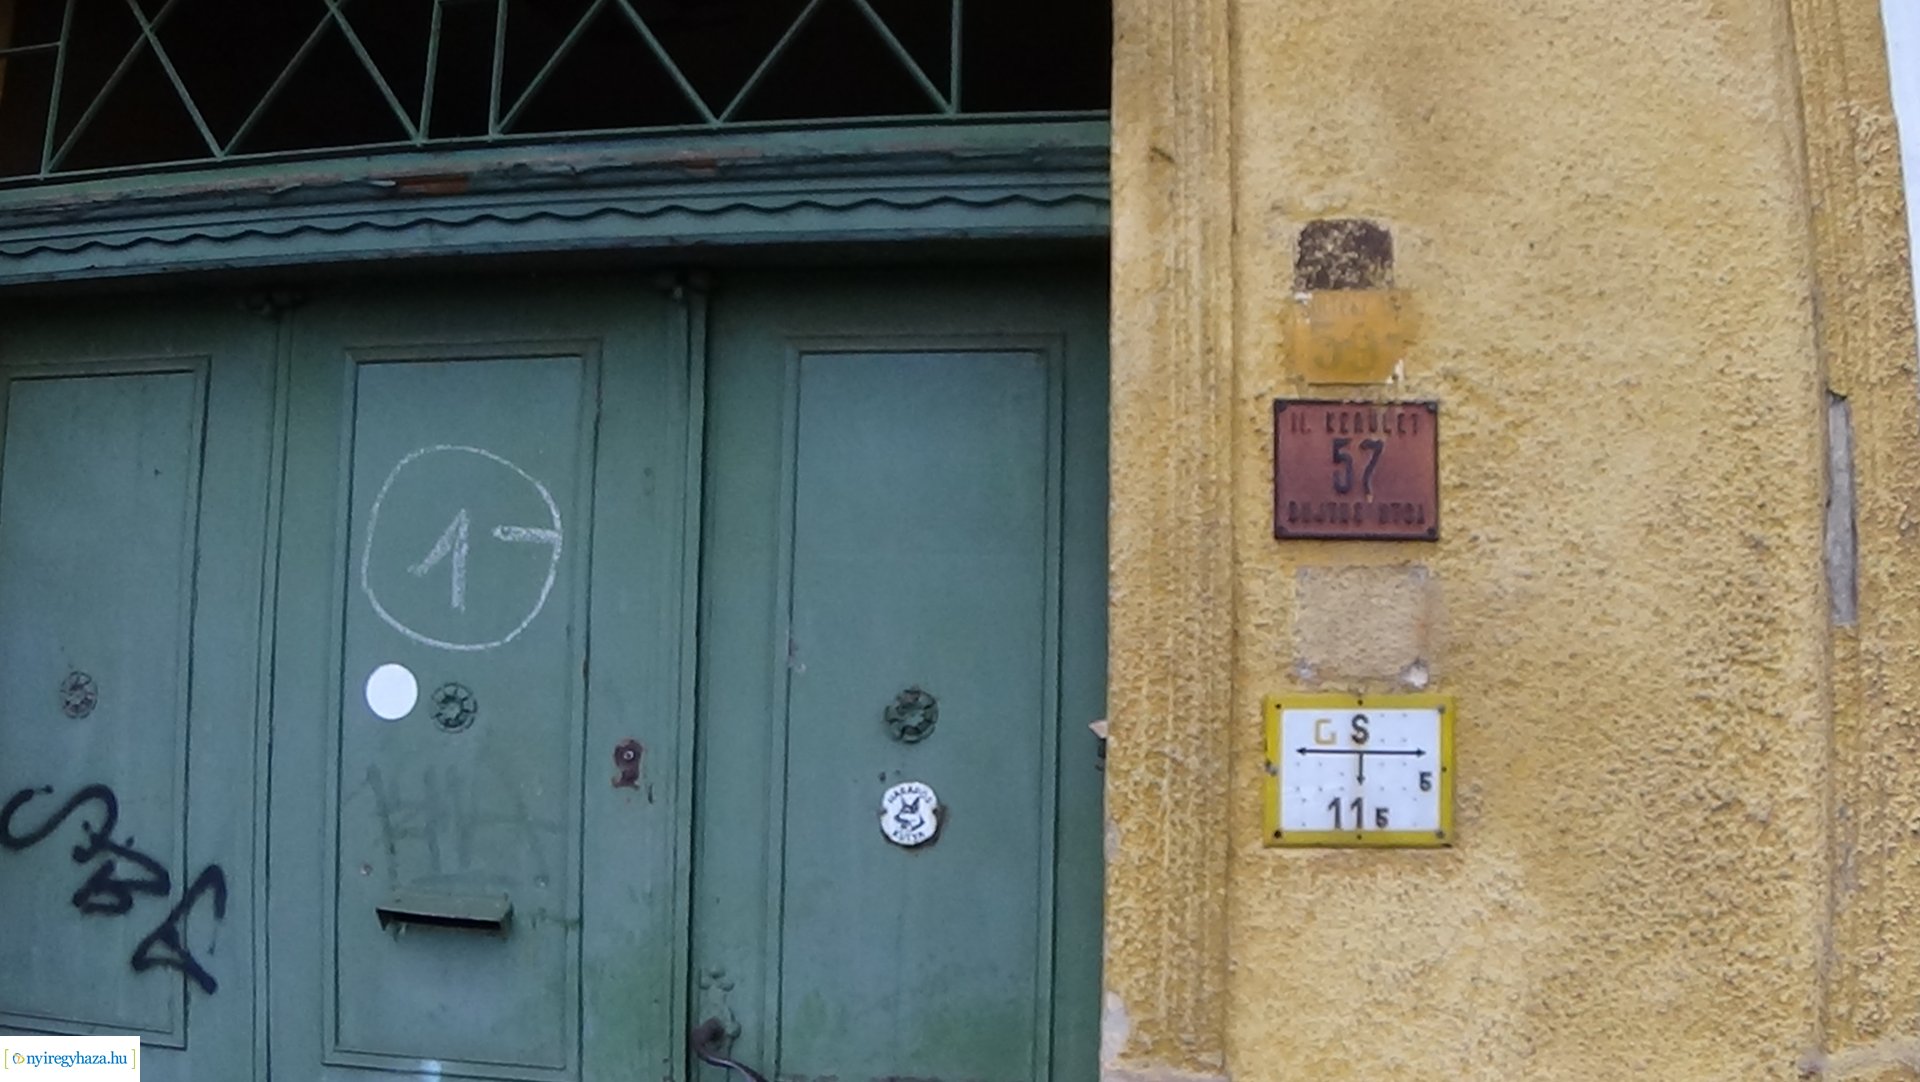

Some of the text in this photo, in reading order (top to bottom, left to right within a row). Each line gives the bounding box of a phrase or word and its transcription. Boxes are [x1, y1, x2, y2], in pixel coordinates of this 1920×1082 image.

[1332, 438, 1384, 499] 57
[1351, 713, 1370, 744] S
[1328, 797, 1364, 829] 11
